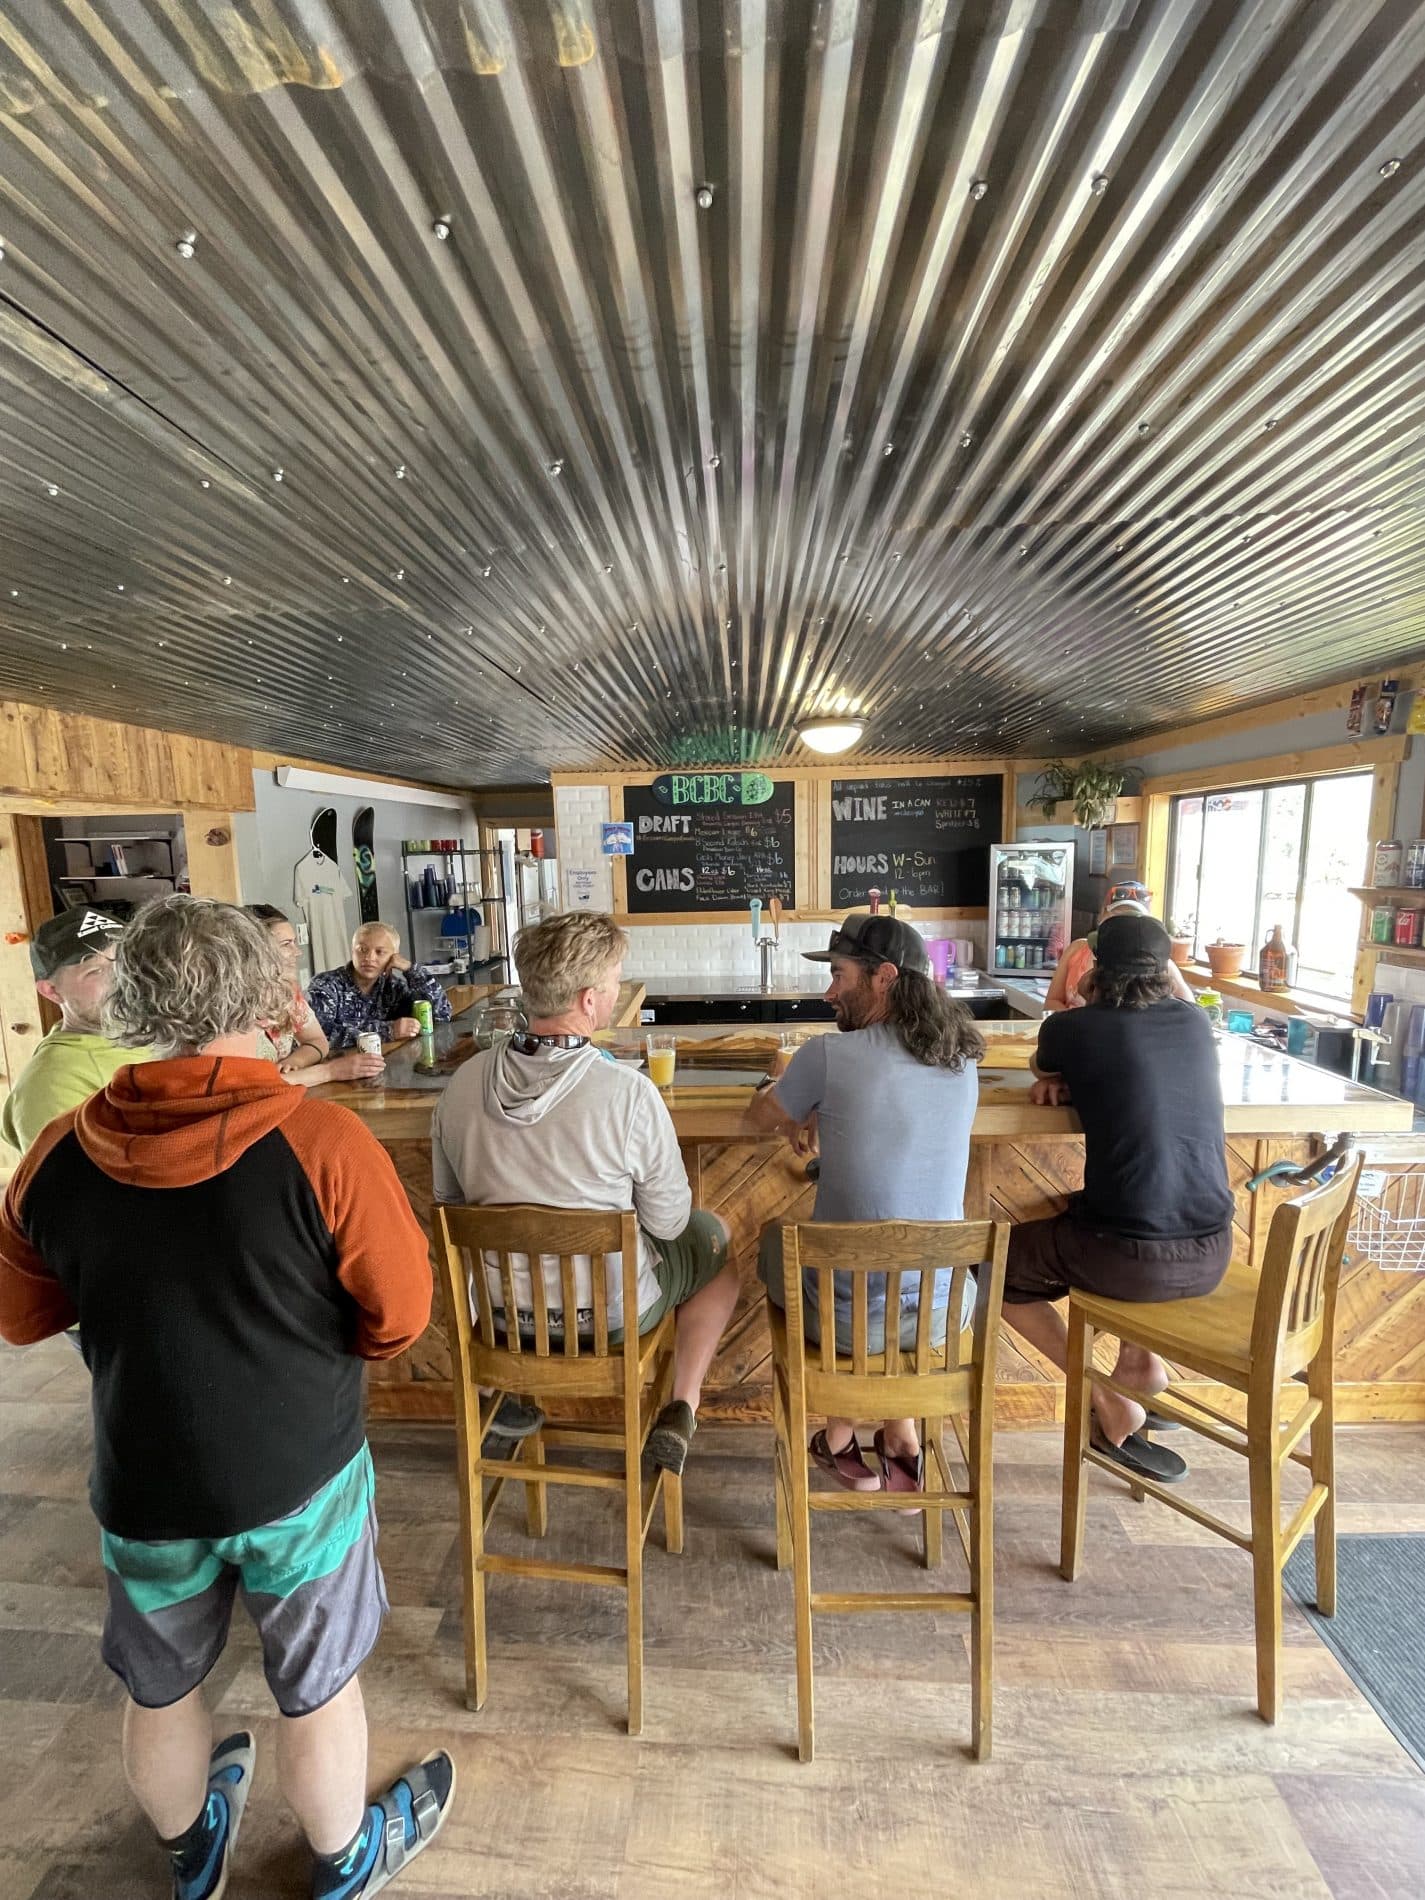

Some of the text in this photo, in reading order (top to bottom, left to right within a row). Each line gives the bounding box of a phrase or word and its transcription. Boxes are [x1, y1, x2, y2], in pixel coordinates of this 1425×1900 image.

[672, 774, 734, 804] BCBC
[832, 796, 888, 822] WINE
[891, 801, 905, 809] IN
[907, 799, 913, 807] A
[914, 798, 931, 807] CAN
[638, 815, 692, 834] DRAFT
[833, 853, 889, 875] HOURS
[635, 867, 695, 892] CANS
